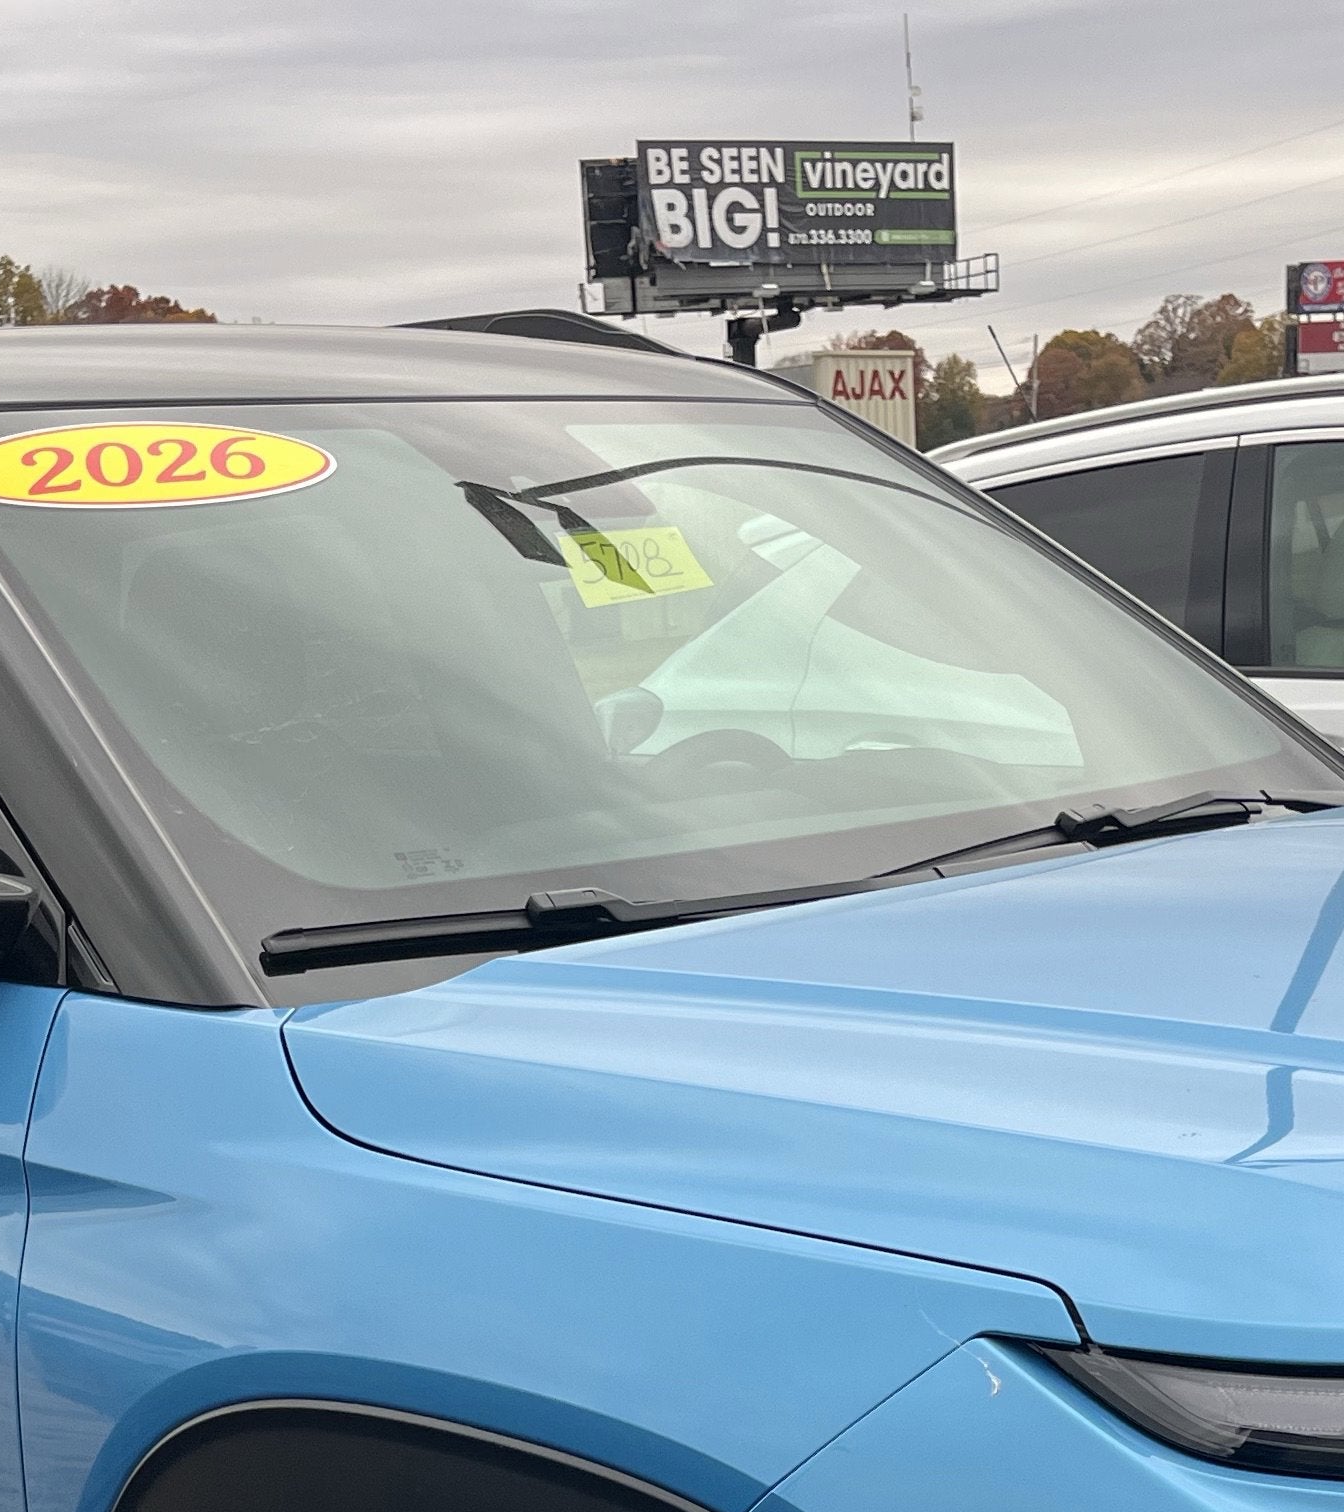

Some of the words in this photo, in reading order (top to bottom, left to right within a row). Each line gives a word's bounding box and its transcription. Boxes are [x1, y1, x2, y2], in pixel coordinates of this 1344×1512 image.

[646, 148, 690, 184] BE
[701, 147, 785, 184] SEEN
[803, 151, 950, 198] vineyard
[651, 186, 782, 249] BIG!
[805, 202, 875, 218] OUTDOOR
[832, 369, 908, 400] AJAX
[20, 436, 264, 496] 2026
[580, 537, 684, 584] 5708
